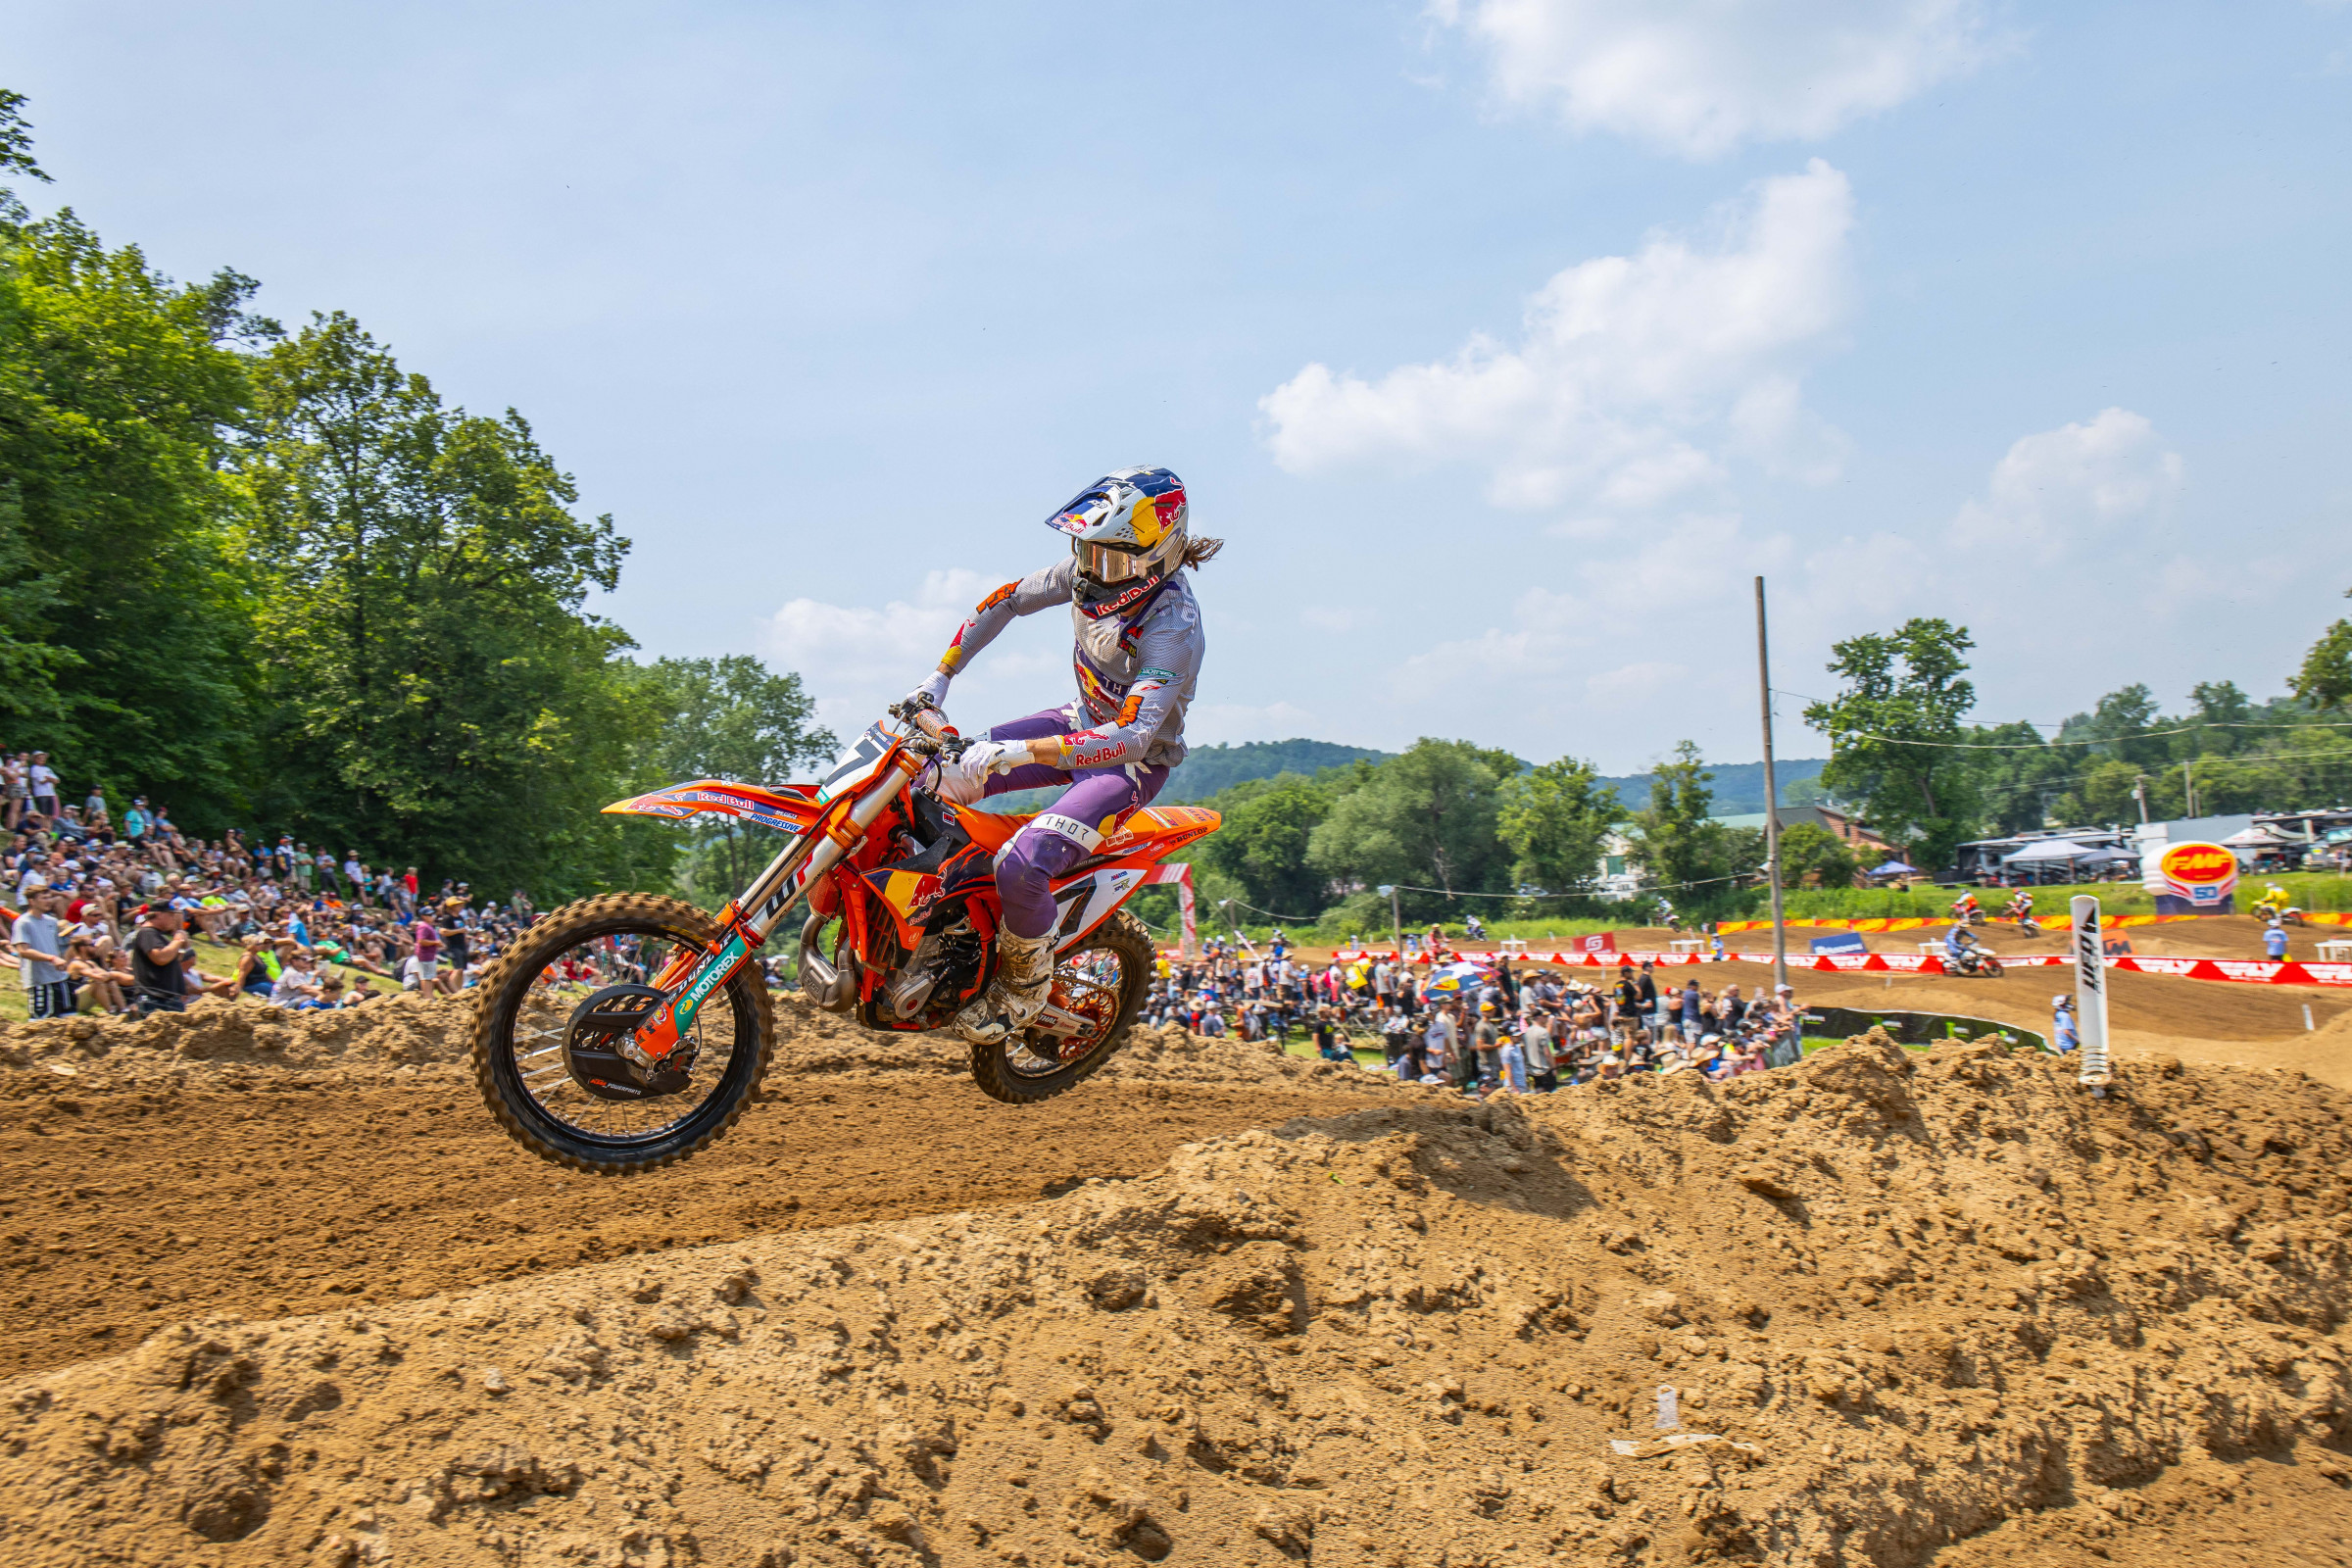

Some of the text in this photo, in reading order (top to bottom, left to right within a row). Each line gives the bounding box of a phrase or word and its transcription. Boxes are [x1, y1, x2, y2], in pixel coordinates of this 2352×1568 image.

[1065, 523, 1084, 534] Bull
[1096, 575, 1159, 616] Red Bull
[1075, 742, 1126, 766] Red Bull
[697, 792, 755, 810] Red Bull
[750, 812, 801, 833] PROGRESSIVE
[1177, 826, 1208, 843] DUNLOP
[2168, 853, 2231, 871] FMF
[678, 934, 732, 994] DUNLP
[2131, 958, 2199, 974] FLY
[2211, 961, 2285, 978] FLY
[690, 951, 741, 1002] MOTOREX
[1040, 1015, 1057, 1025] THAL
